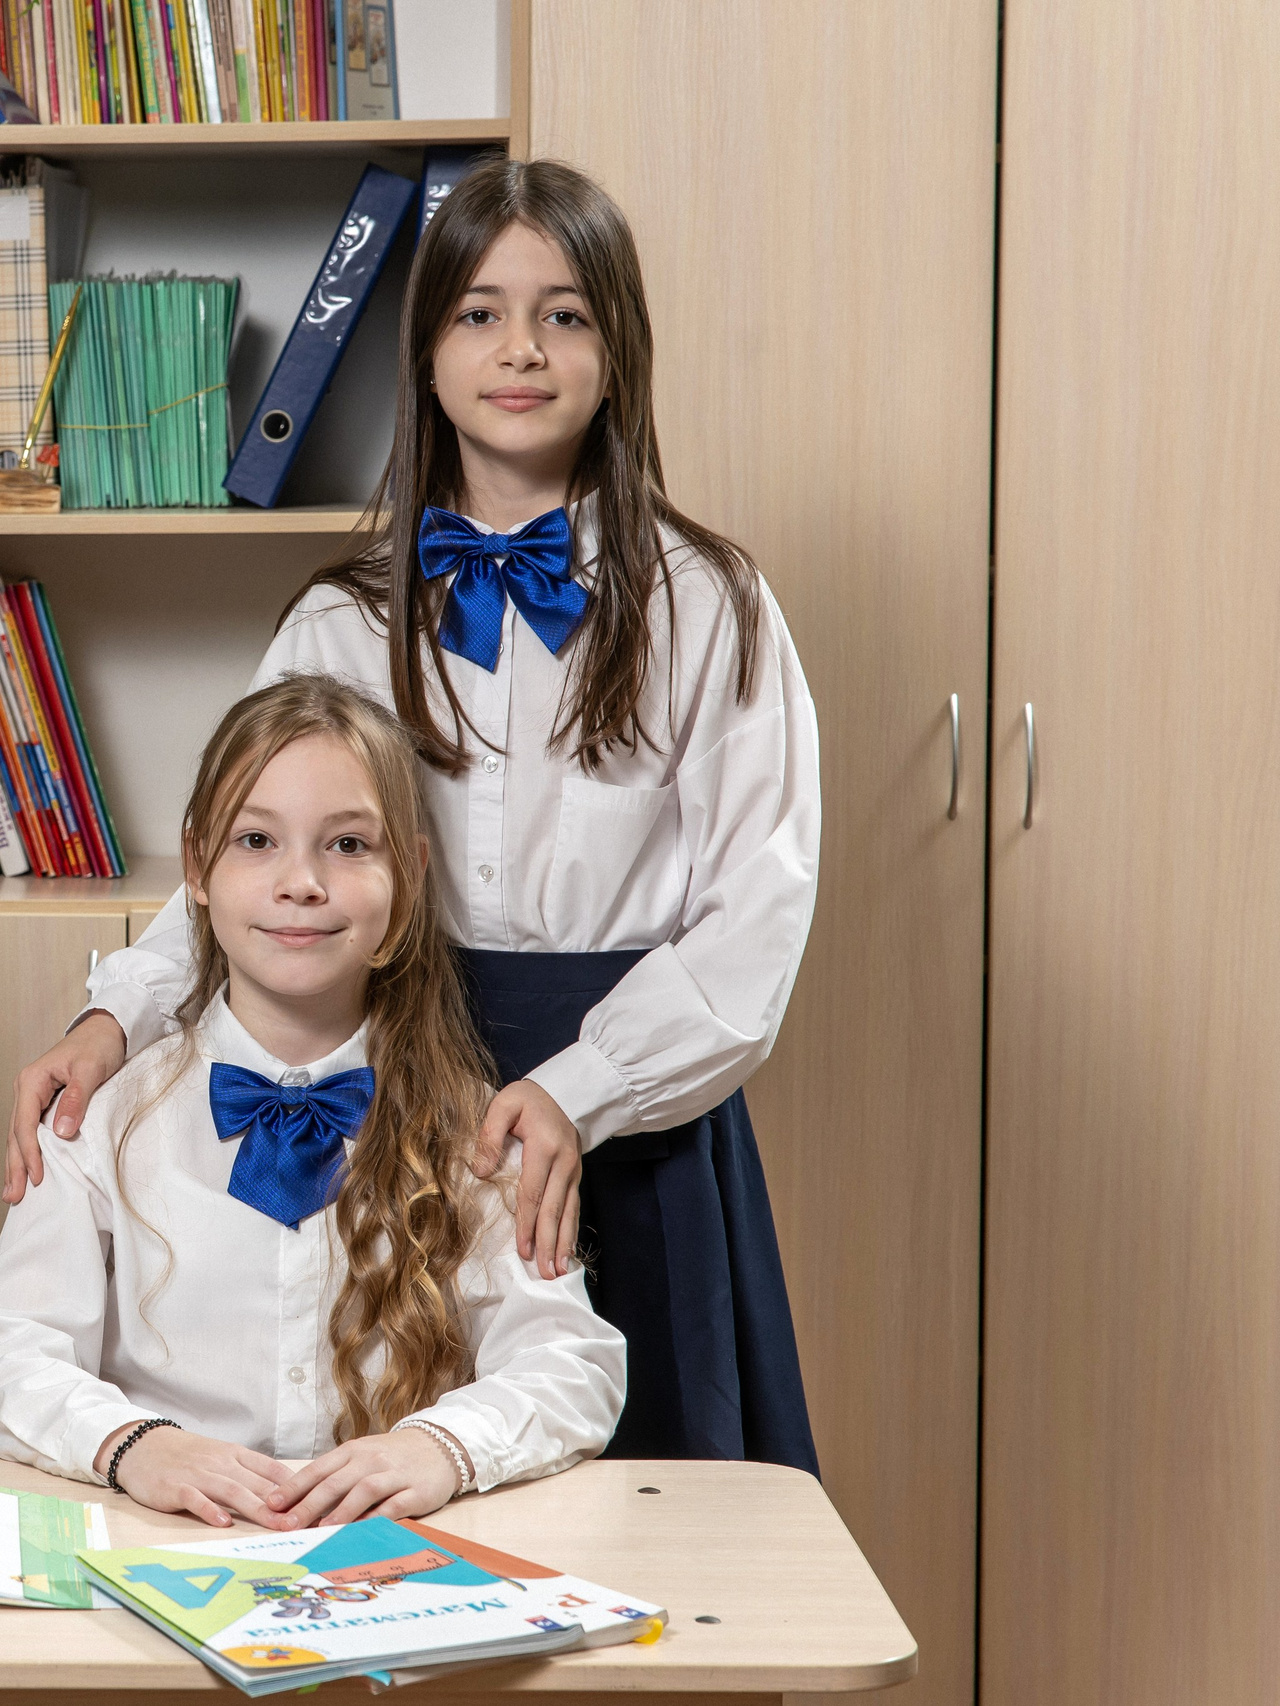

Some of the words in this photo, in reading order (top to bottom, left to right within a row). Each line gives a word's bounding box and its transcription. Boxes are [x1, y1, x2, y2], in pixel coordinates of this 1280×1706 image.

[246, 1540, 306, 1549] Часть
[121, 1563, 236, 1610] 4
[245, 1597, 511, 1637] Математика
